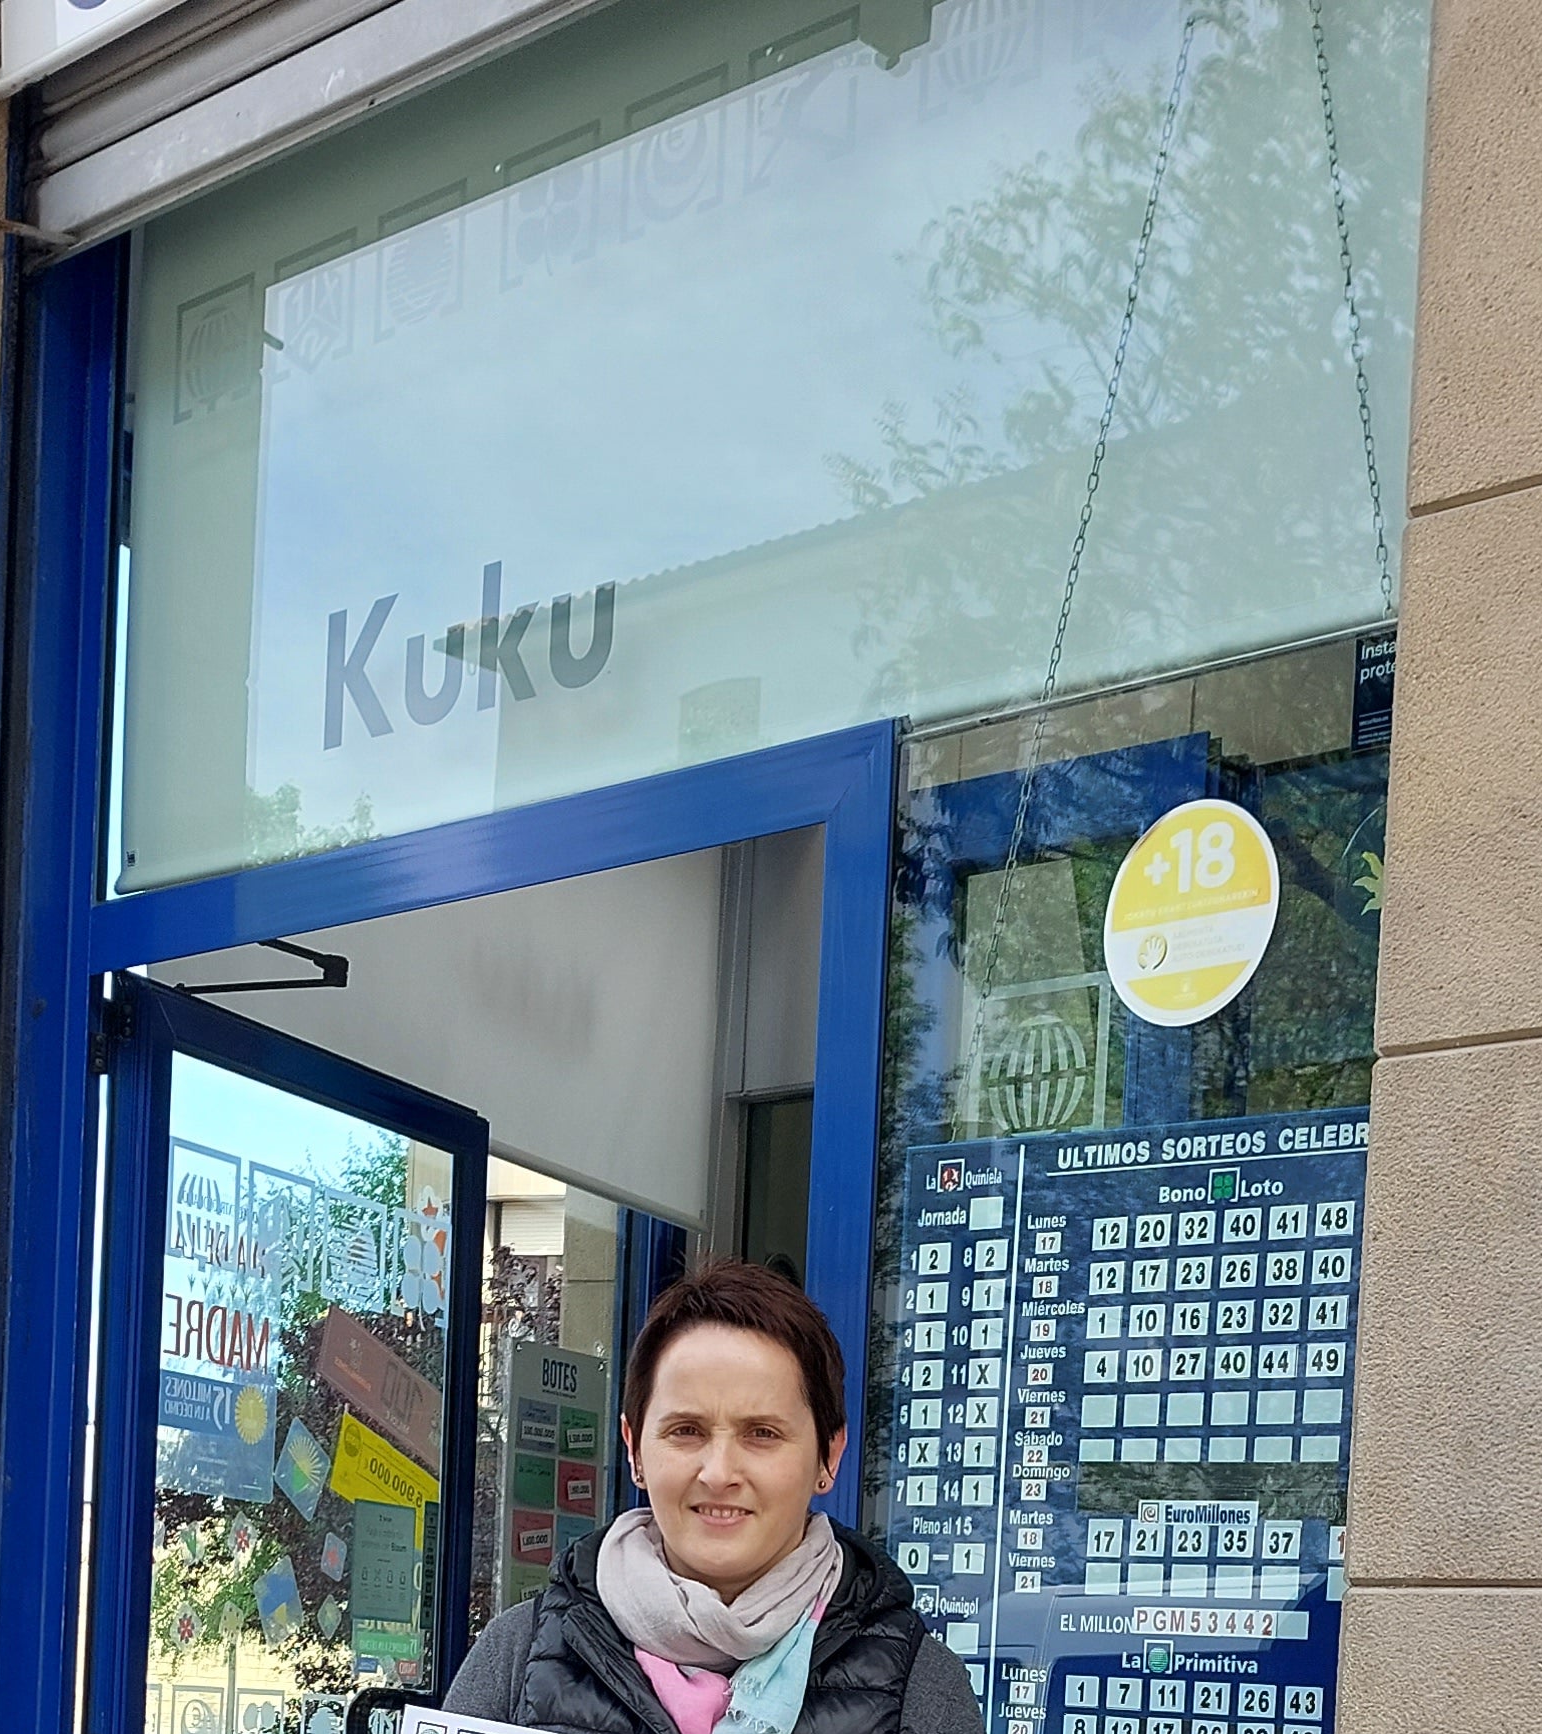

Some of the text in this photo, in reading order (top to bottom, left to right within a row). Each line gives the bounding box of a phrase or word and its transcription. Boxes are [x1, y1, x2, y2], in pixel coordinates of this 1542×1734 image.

[324, 560, 615, 750] Kuku
[1361, 641, 1396, 660] Insta
[1360, 660, 1395, 684] prote
[1144, 821, 1235, 893] +18
[1058, 1122, 1369, 1170] ULTIMOS SORTEOS CELEBR
[926, 1168, 1003, 1190] La Quiniela
[1159, 1179, 1283, 1203] Bono Loto
[918, 1208, 967, 1227] Jornada
[1027, 1213, 1067, 1231] Lunes
[1101, 1207, 1348, 1244] 12 20 32 40 41 48
[1024, 1256, 1070, 1274] Martes
[1096, 1254, 1346, 1288] 12 17 23 26 38 40
[1022, 1299, 1085, 1317] Miércoles
[1099, 1300, 1339, 1333] 1 10 16 23 32 41
[1020, 1344, 1066, 1360] Jueves
[1096, 1347, 1339, 1378] 4 10 27 40 44 49
[543, 1359, 576, 1392] BOTES
[1017, 1388, 1066, 1404] Viernes
[1014, 1431, 1063, 1448] Sábado
[1012, 1464, 1070, 1480] Domingo
[1009, 1510, 1053, 1526] Martes
[1165, 1504, 1250, 1524] EuroMillones
[913, 1517, 972, 1535] Pleno al 15
[1094, 1529, 1293, 1553] 17 21 23 35 37
[1008, 1552, 1056, 1569] Viernes
[940, 1597, 979, 1615] Quinigol
[1060, 1615, 1136, 1633] EL MILLON
[1121, 1652, 1258, 1674] La Primitiva
[1002, 1665, 1046, 1682] Lunes
[1077, 1682, 1317, 1713] 1 7 11 21 26 43
[998, 1705, 1046, 1720] Jueves
